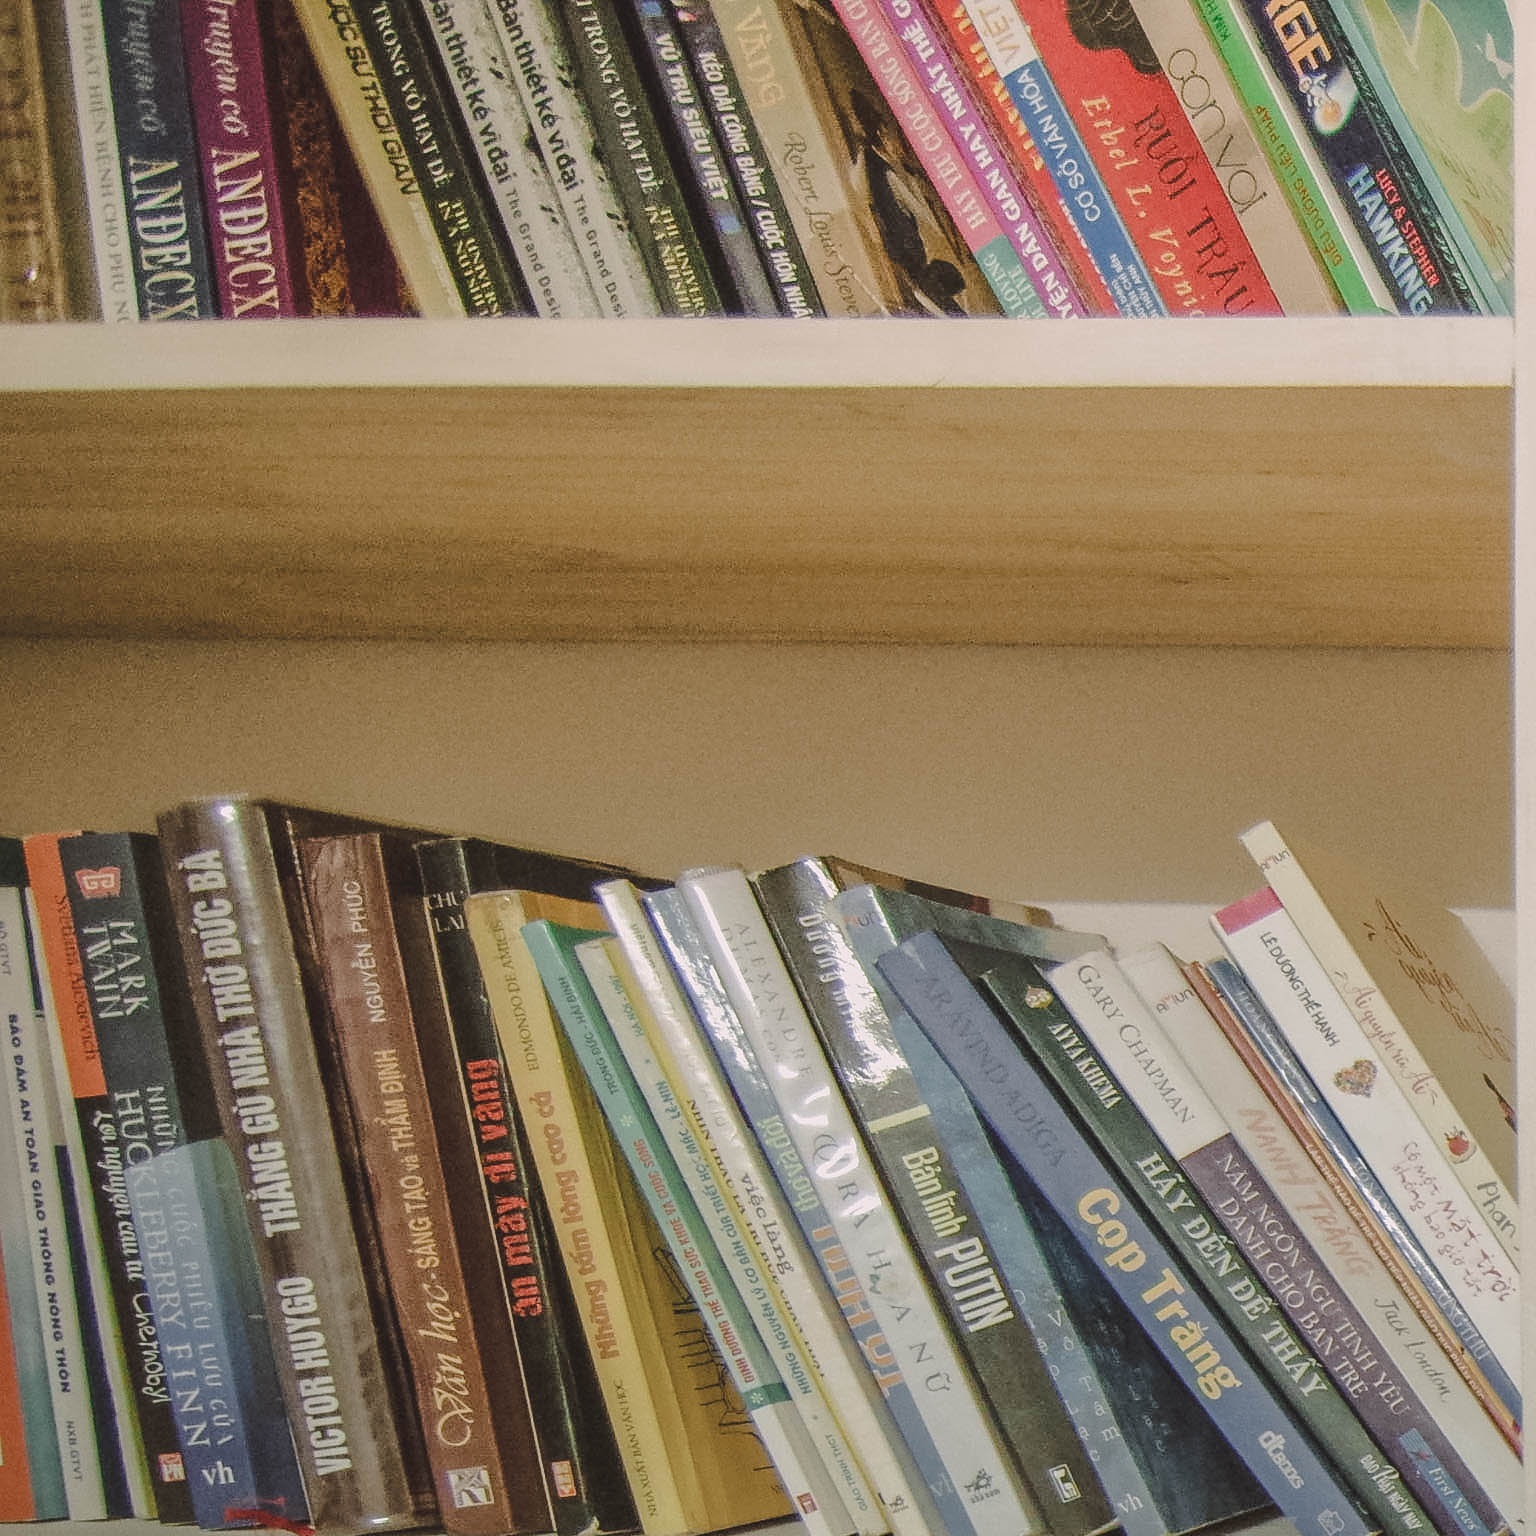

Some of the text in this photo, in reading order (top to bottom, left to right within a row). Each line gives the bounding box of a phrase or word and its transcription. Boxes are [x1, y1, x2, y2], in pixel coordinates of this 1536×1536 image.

[109, 921, 148, 1015] MARK
[1118, 1023, 1195, 1123] CHAPMAN
[935, 1238, 1011, 1331] PUTIN
[165, 1342, 210, 1446] FINN
[278, 1277, 349, 1475] VICTOR HUYGO
